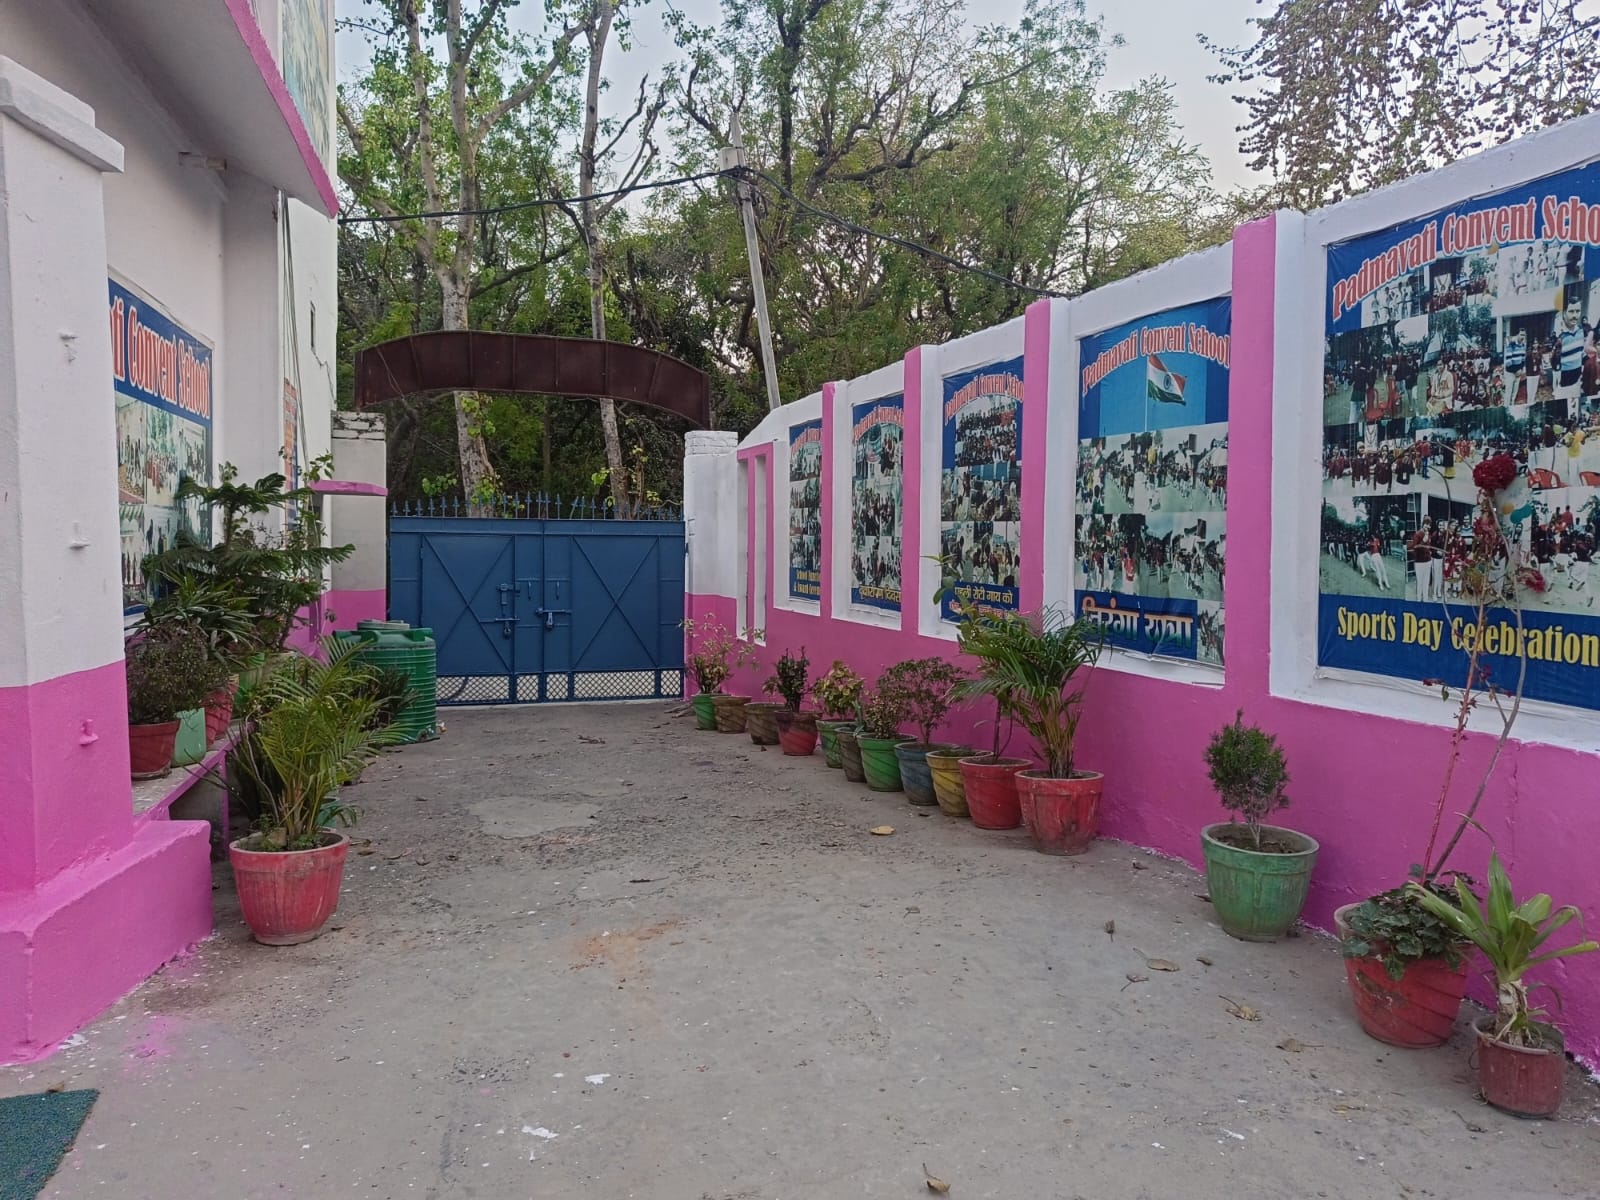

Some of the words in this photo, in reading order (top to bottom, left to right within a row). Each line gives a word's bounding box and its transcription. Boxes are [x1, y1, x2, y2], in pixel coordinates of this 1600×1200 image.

[1333, 220, 1437, 322] Padmavati
[1441, 197, 1536, 256] Convent
[109, 295, 125, 381] ti
[128, 305, 177, 404] Convent
[178, 338, 210, 419] School
[1082, 329, 1138, 396] Padmavati
[1140, 321, 1186, 356] Convent
[1188, 322, 1230, 369] School
[1144, 613, 1193, 649] यात्रा
[1337, 606, 1396, 642] Sports
[1402, 612, 1443, 651] Day
